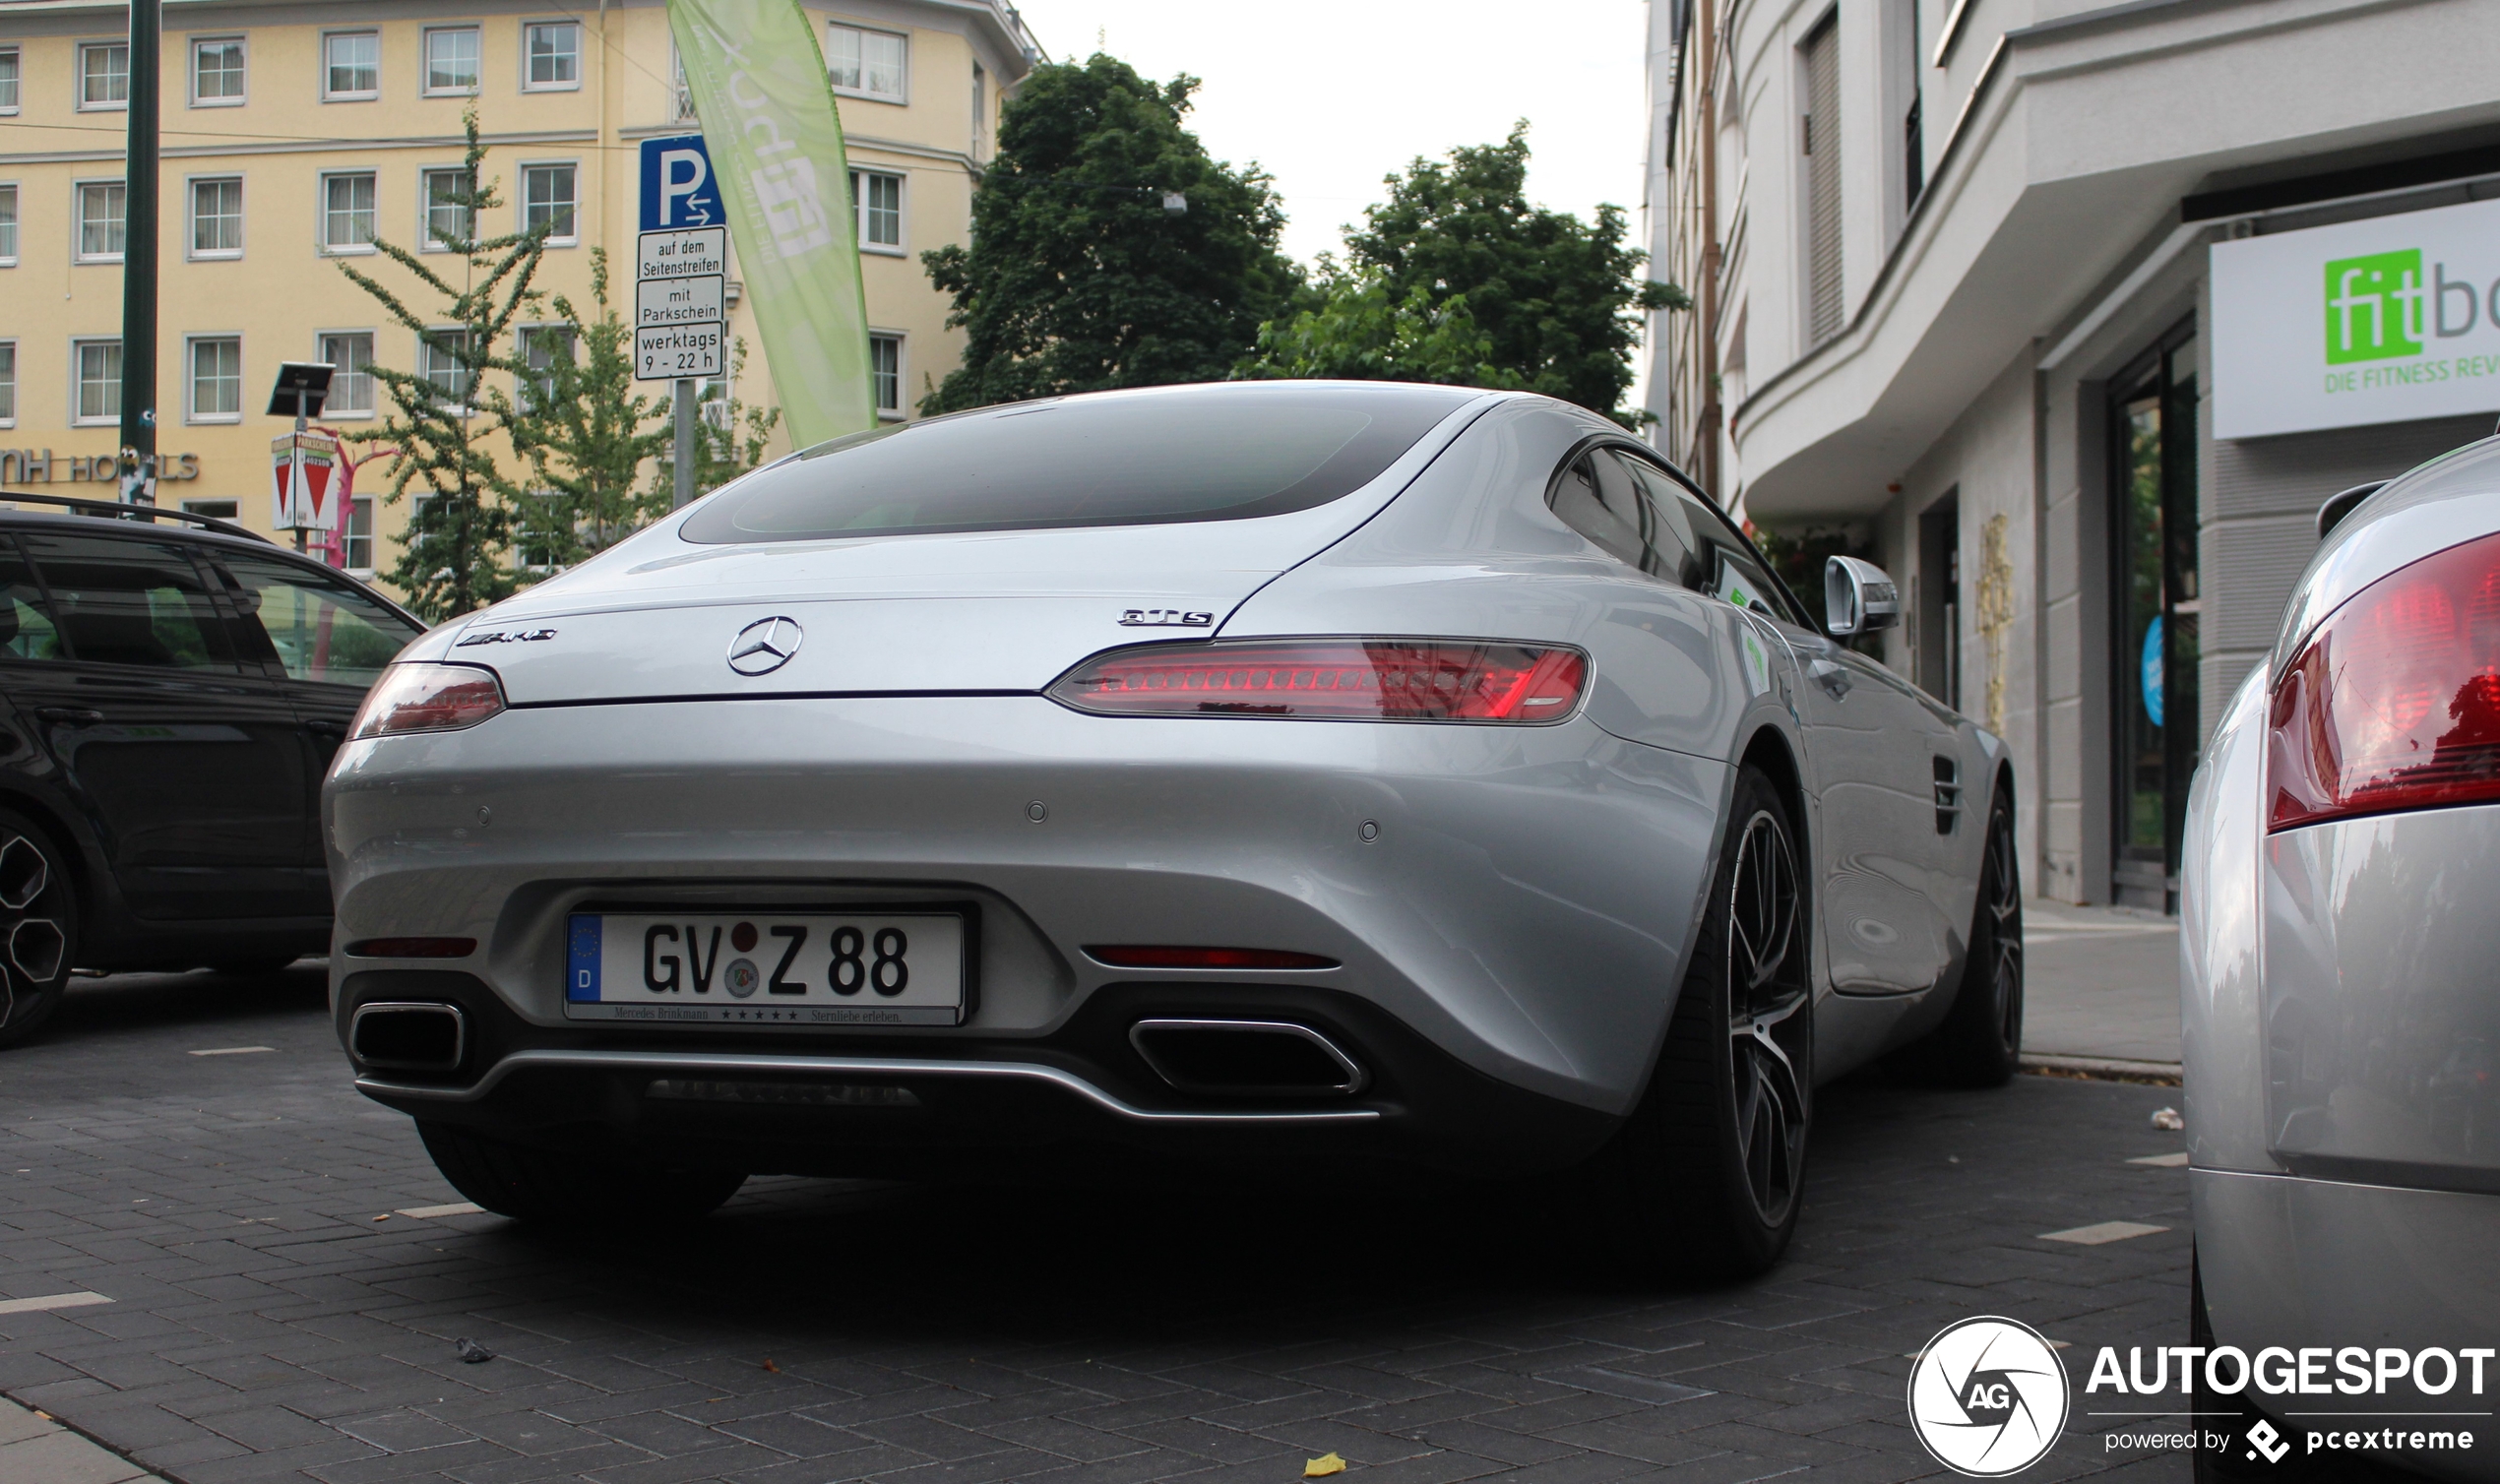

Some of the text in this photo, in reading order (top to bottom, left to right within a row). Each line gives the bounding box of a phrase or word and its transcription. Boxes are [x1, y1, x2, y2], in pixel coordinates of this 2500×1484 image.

[660, 149, 706, 225] P
[658, 240, 705, 256] auf dem
[644, 258, 719, 277] Seitenstreifen
[669, 288, 691, 302] mit
[643, 304, 717, 322] Parkschein
[642, 333, 717, 350] werktags
[646, 355, 654, 372] 9
[677, 352, 696, 369] 22
[704, 351, 713, 367] h
[2325, 371, 2357, 394] DIE
[2364, 360, 2450, 389] FITNESS
[70, 453, 198, 482] HOLS
[644, 924, 722, 994] GV
[768, 926, 808, 995] Z
[828, 926, 908, 996] 88
[579, 969, 591, 988] D
[614, 1006, 902, 1022] Mercedes Brinkmann Sternliebe erleben.
